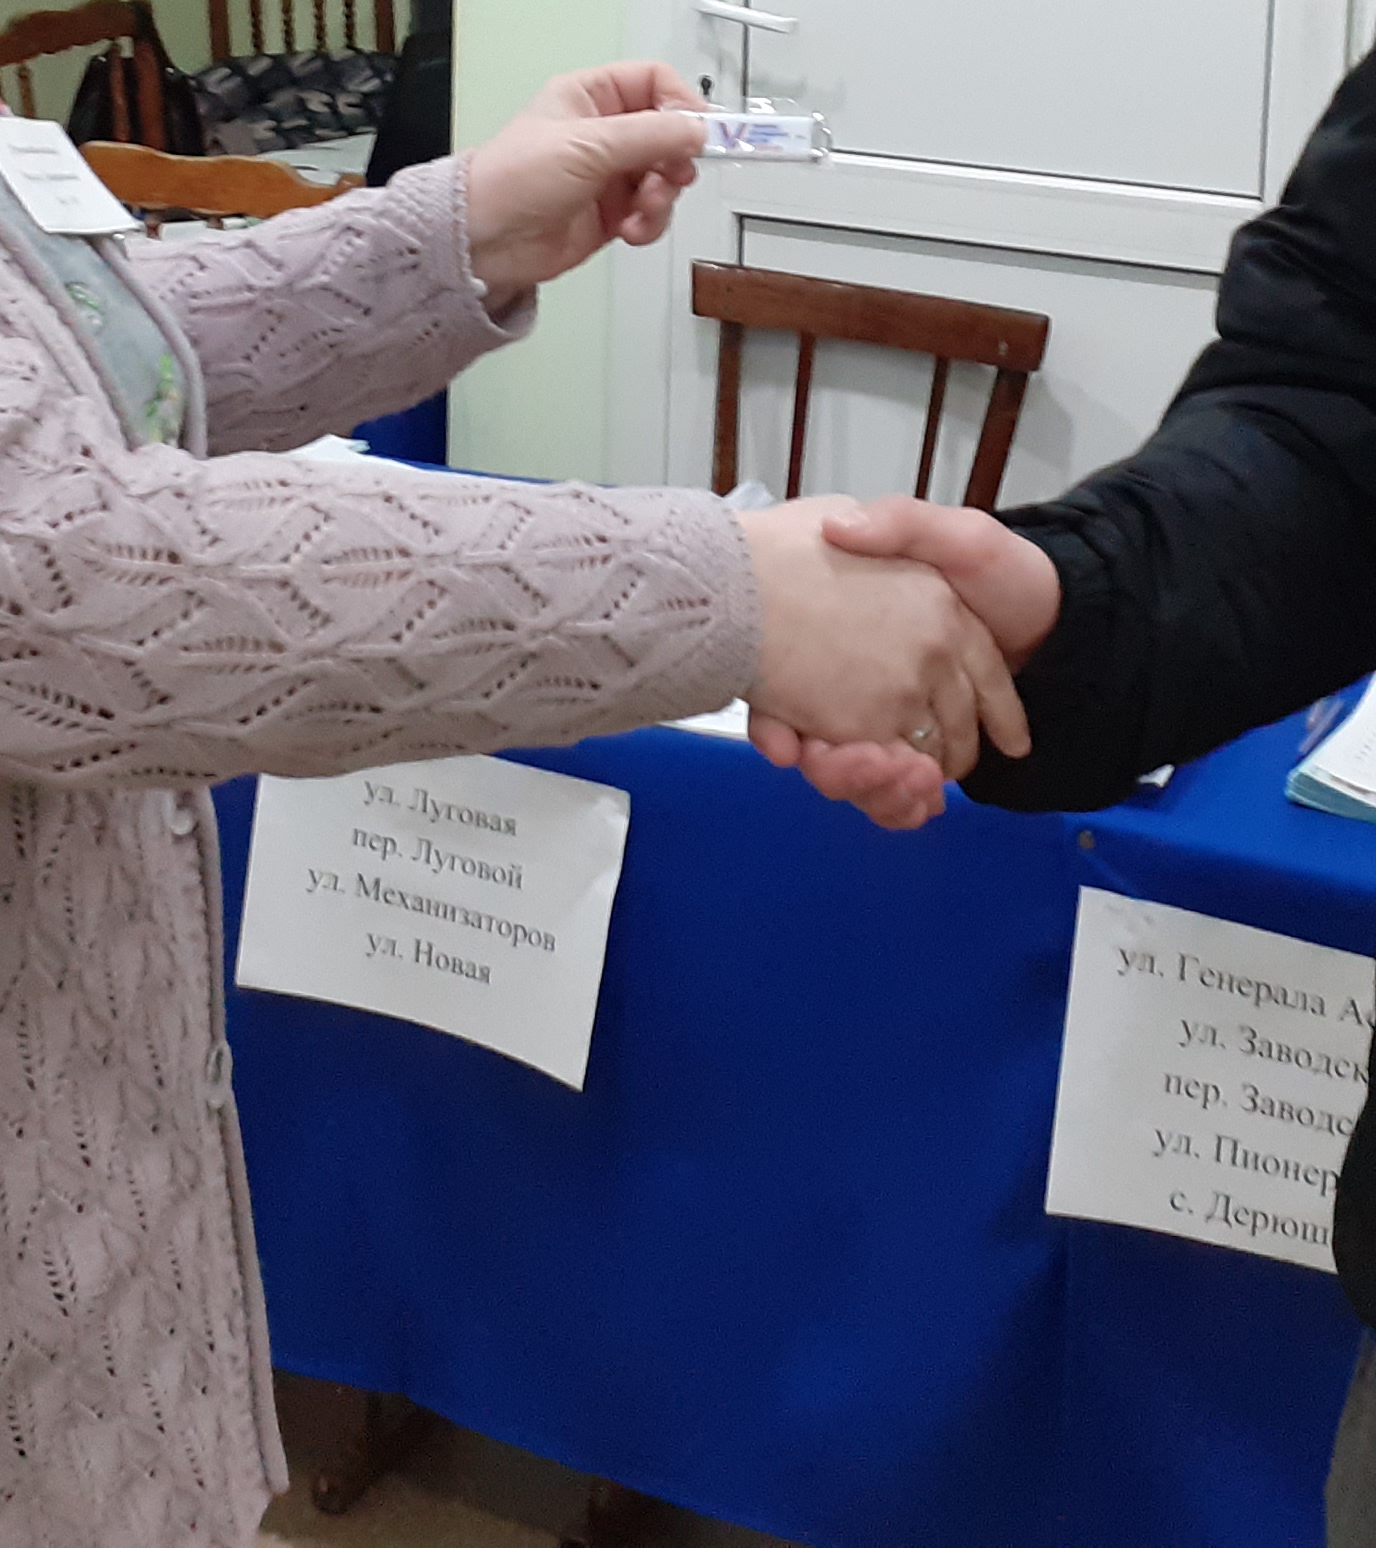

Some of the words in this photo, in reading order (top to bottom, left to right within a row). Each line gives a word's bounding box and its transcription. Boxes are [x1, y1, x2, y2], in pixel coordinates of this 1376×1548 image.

[362, 780, 400, 805] ул.
[409, 788, 517, 837] Луговая
[352, 826, 403, 861] пер.
[411, 838, 523, 890] Луговой
[306, 868, 345, 893] ул.
[356, 872, 556, 952] Механизаторов
[366, 932, 403, 958] ул.
[414, 938, 492, 985] Новая
[1116, 947, 1165, 979] ул.
[1177, 955, 1326, 1017] Генерала
[1179, 1018, 1226, 1049] ул.
[1163, 1071, 1227, 1109] пер.
[1152, 1127, 1201, 1158] ул.
[1169, 1191, 1194, 1215] с.
